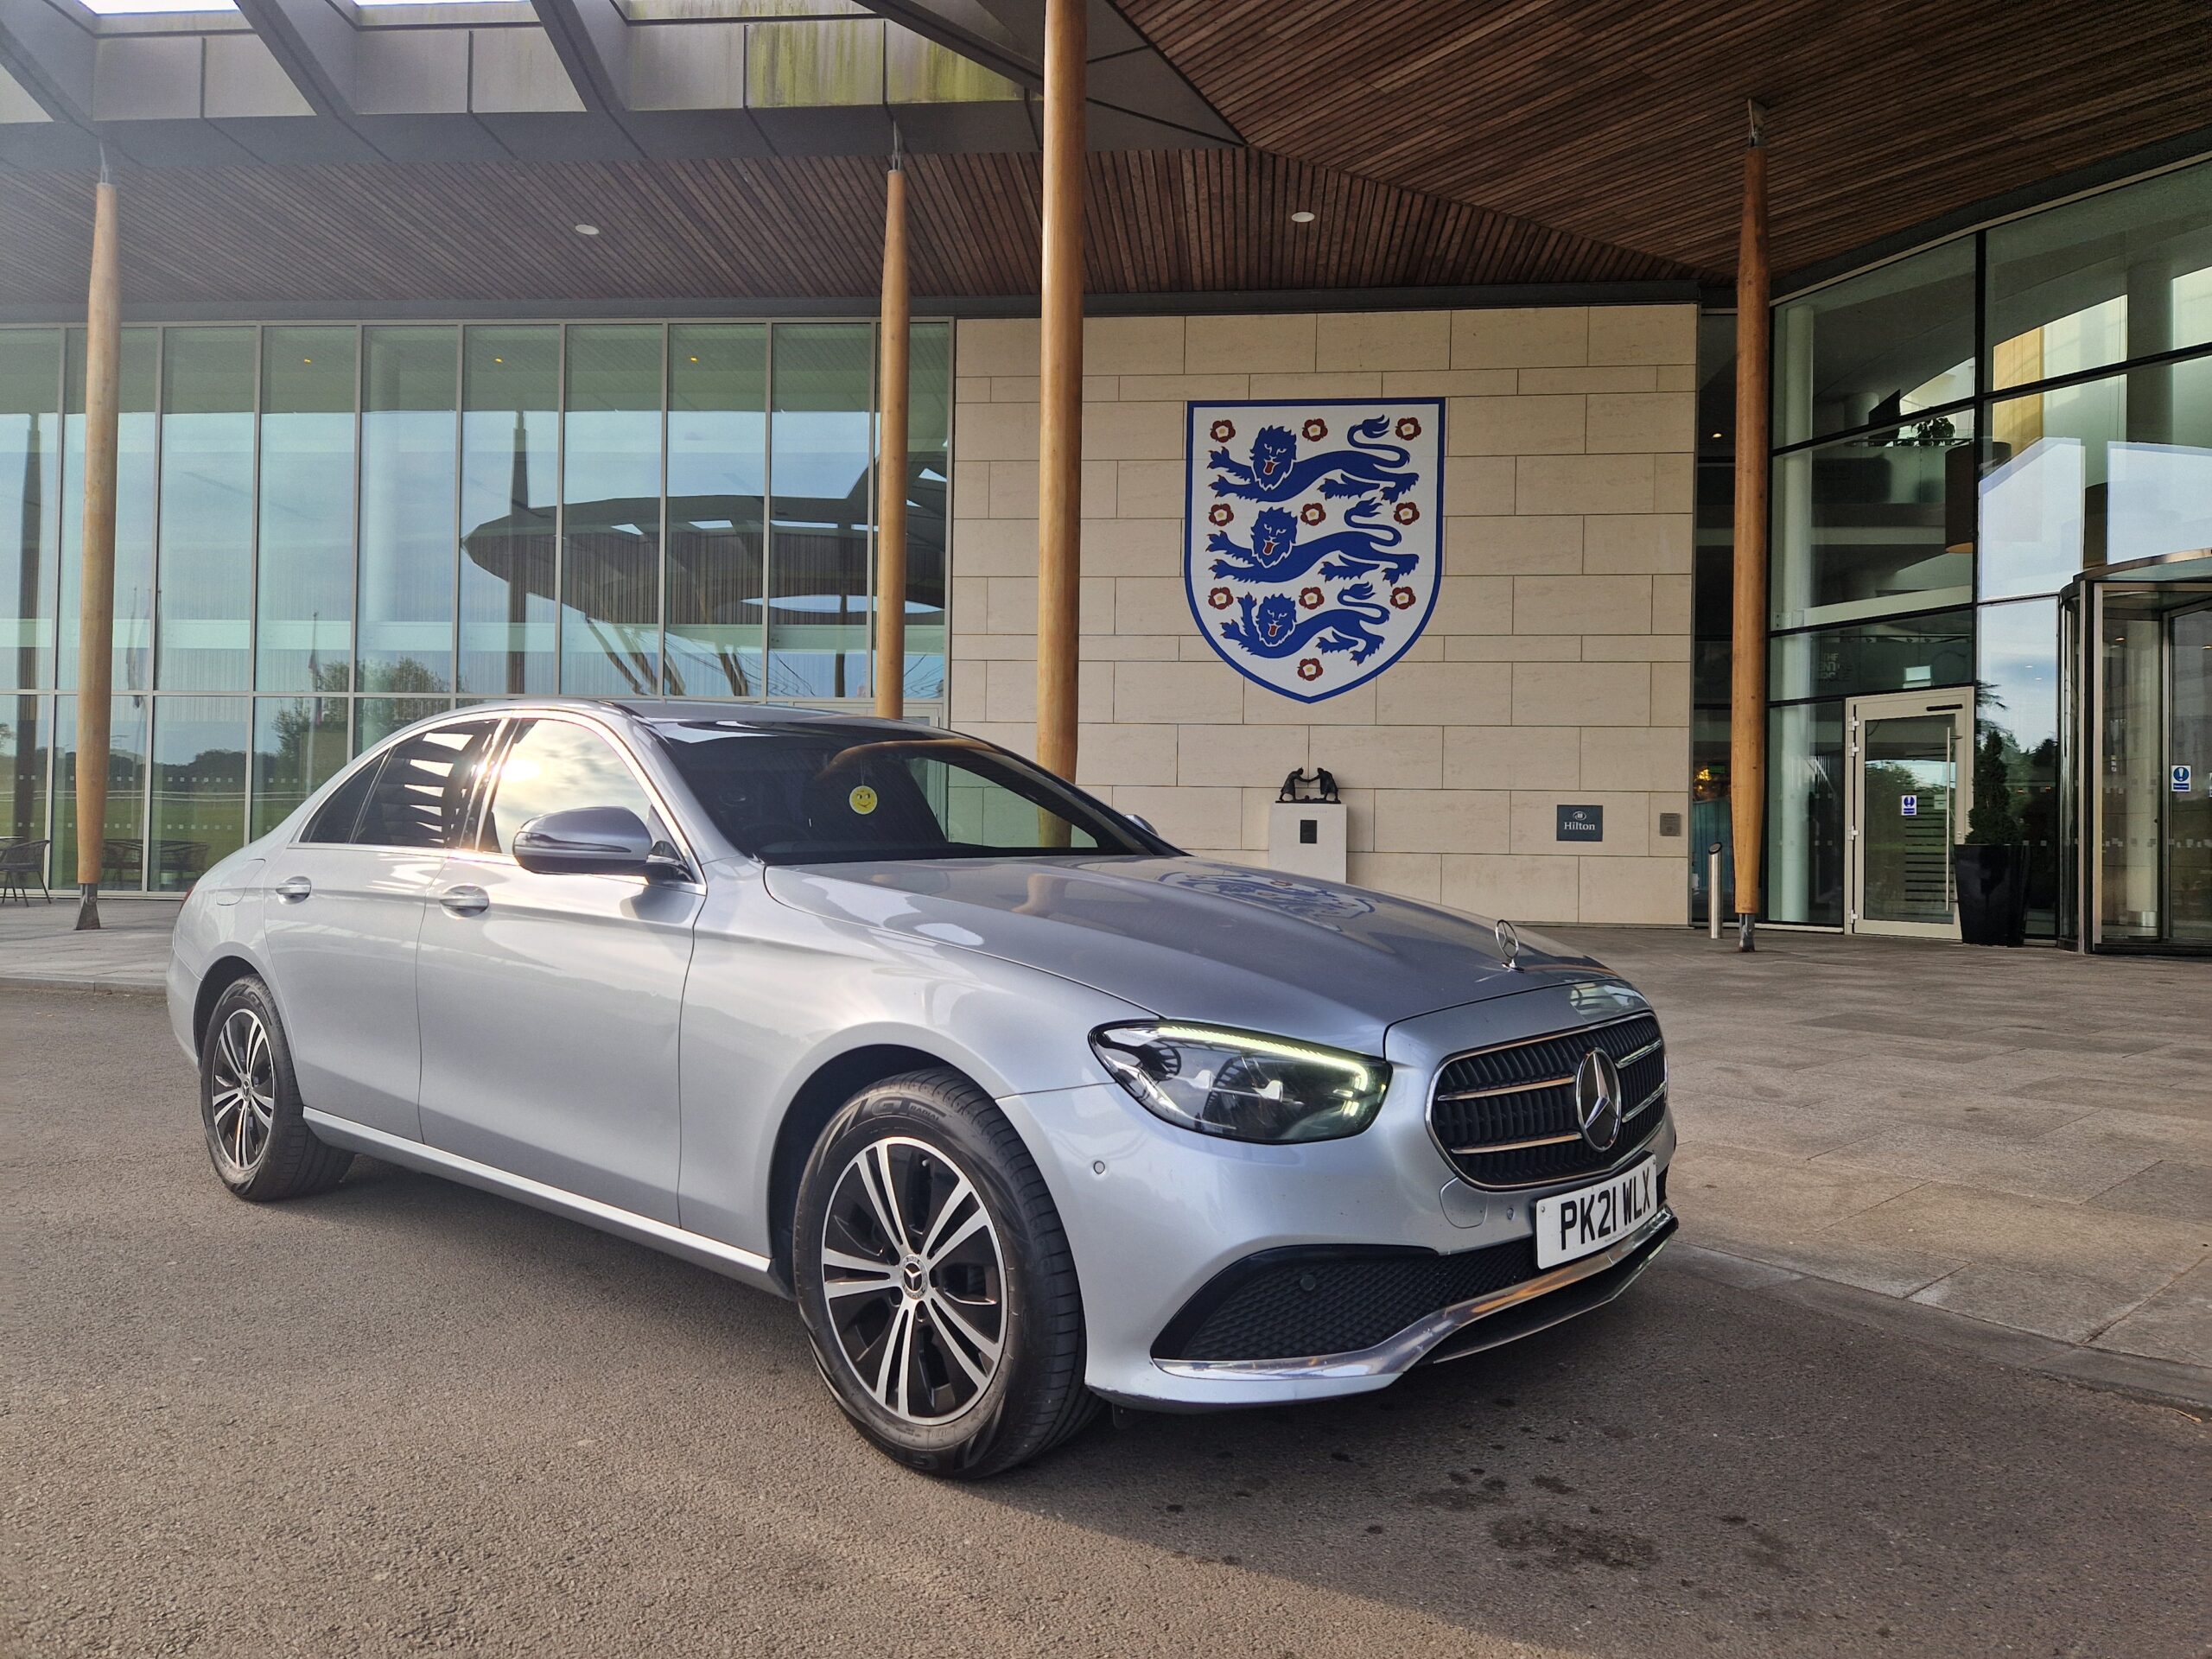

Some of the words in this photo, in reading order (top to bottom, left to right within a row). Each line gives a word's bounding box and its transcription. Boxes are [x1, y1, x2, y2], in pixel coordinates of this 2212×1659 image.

[1564, 821, 1595, 830] Hilton
[909, 1105, 941, 1121] RADIAL
[1560, 1186, 1617, 1250] PK21
[1623, 1166, 1650, 1226] WLX
